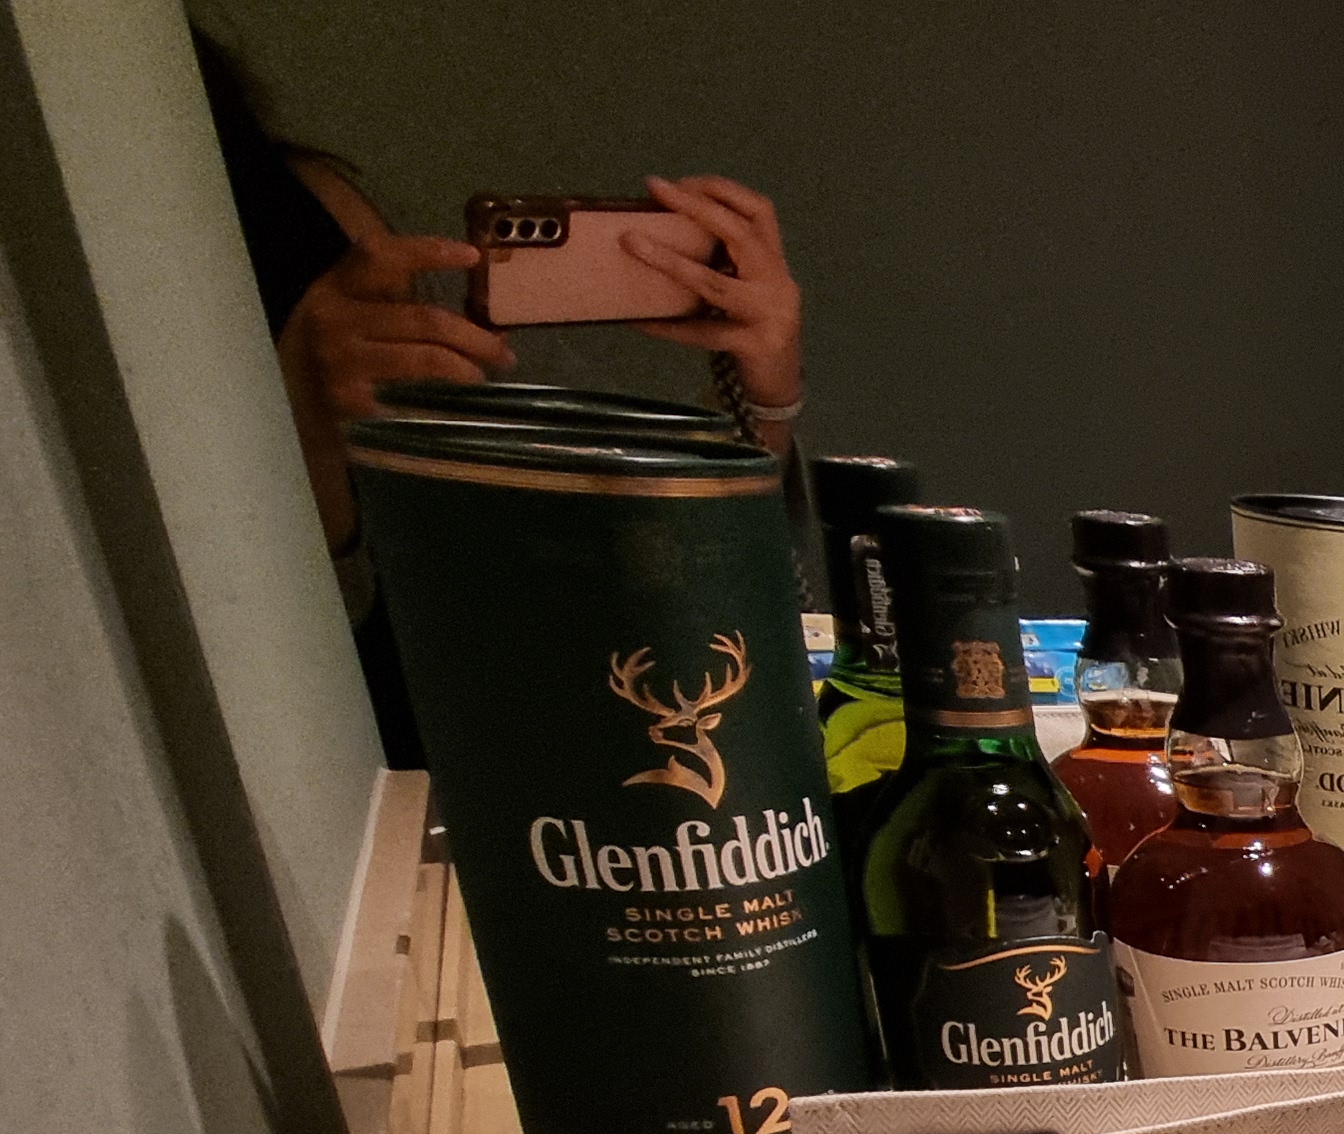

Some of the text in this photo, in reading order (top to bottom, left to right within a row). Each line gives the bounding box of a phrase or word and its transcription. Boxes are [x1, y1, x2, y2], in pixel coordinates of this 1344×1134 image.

[529, 796, 828, 893] Glenfiddich
[625, 889, 794, 922] SINGLE MALT
[607, 927, 723, 942] SCOTCH
[716, 949, 762, 963] FAMILY
[691, 966, 736, 978] SINCE
[1161, 984, 1210, 1003] SINGLE
[1214, 979, 1254, 993] MALT
[1260, 976, 1315, 990] SCOTCH
[1267, 1005, 1332, 1027] Distilled
[940, 1000, 1113, 1067] Glenfiddich
[1164, 1026, 1216, 1050] THE
[990, 1059, 1094, 1084] SINGLE MALT
